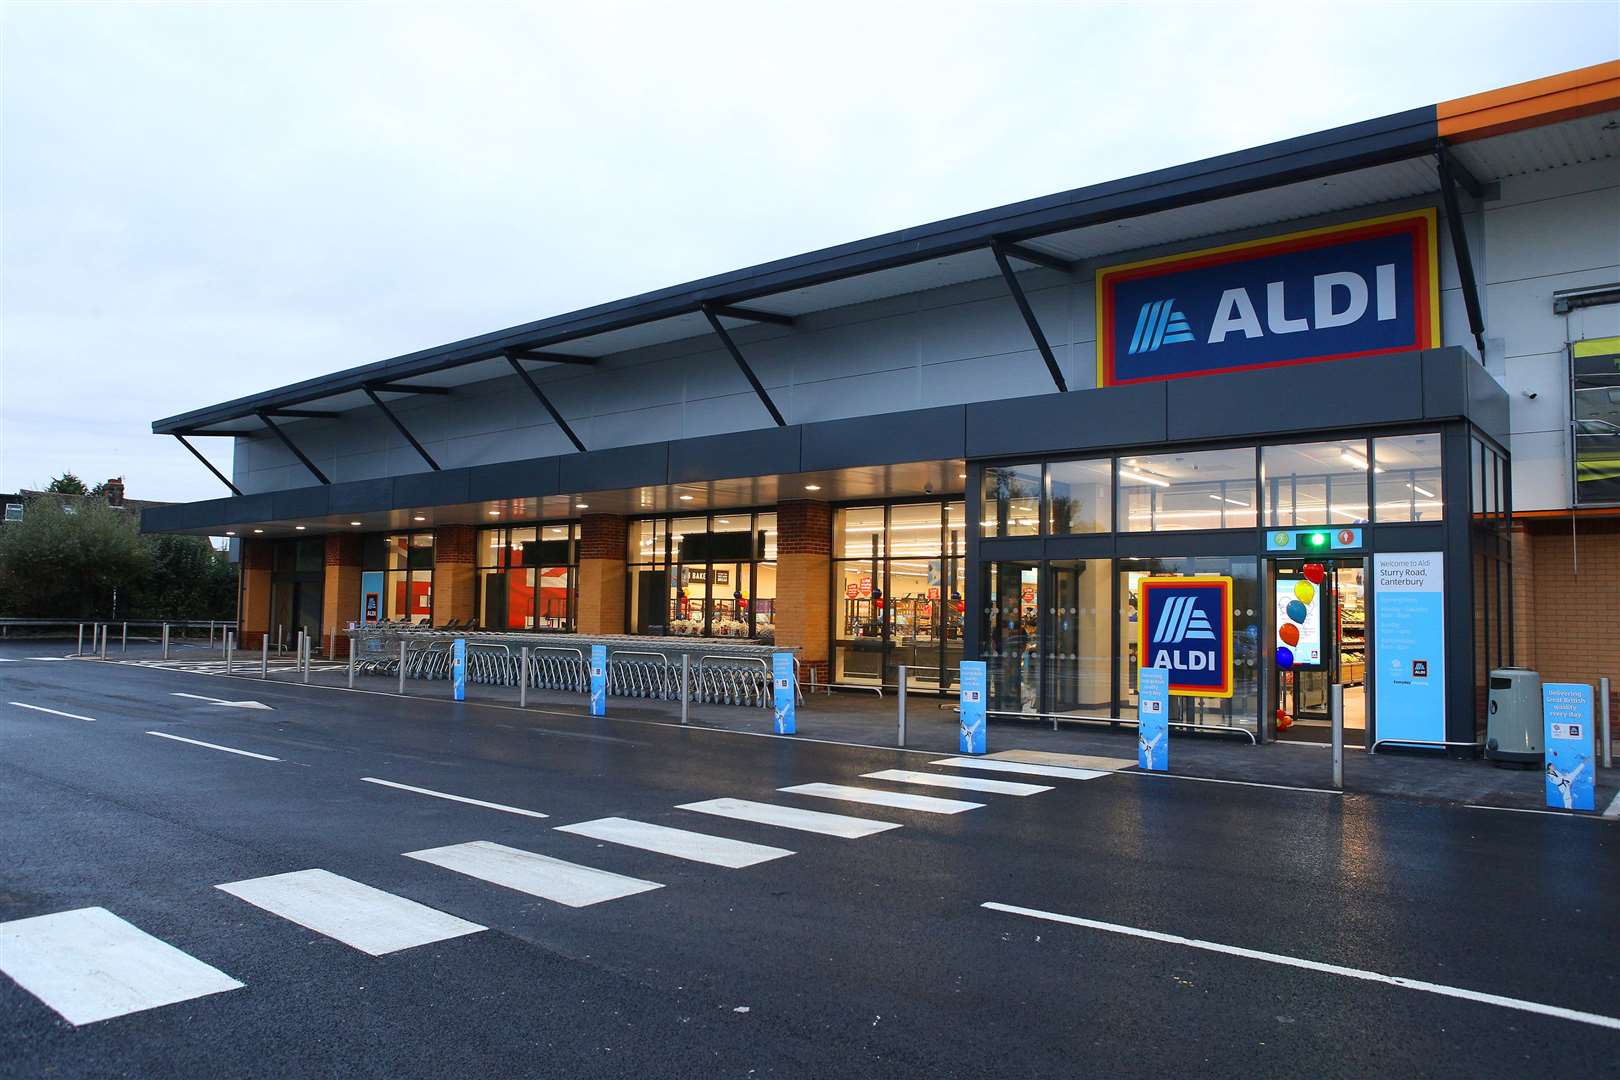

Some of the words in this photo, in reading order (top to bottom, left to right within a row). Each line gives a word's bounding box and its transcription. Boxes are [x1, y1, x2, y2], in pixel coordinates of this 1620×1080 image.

[1207, 263, 1397, 344] ALDI
[1380, 569, 1404, 577] Sturry
[1405, 568, 1428, 576] Road,
[1380, 578, 1424, 586] Canterbury
[1153, 650, 1216, 671] ALDI
